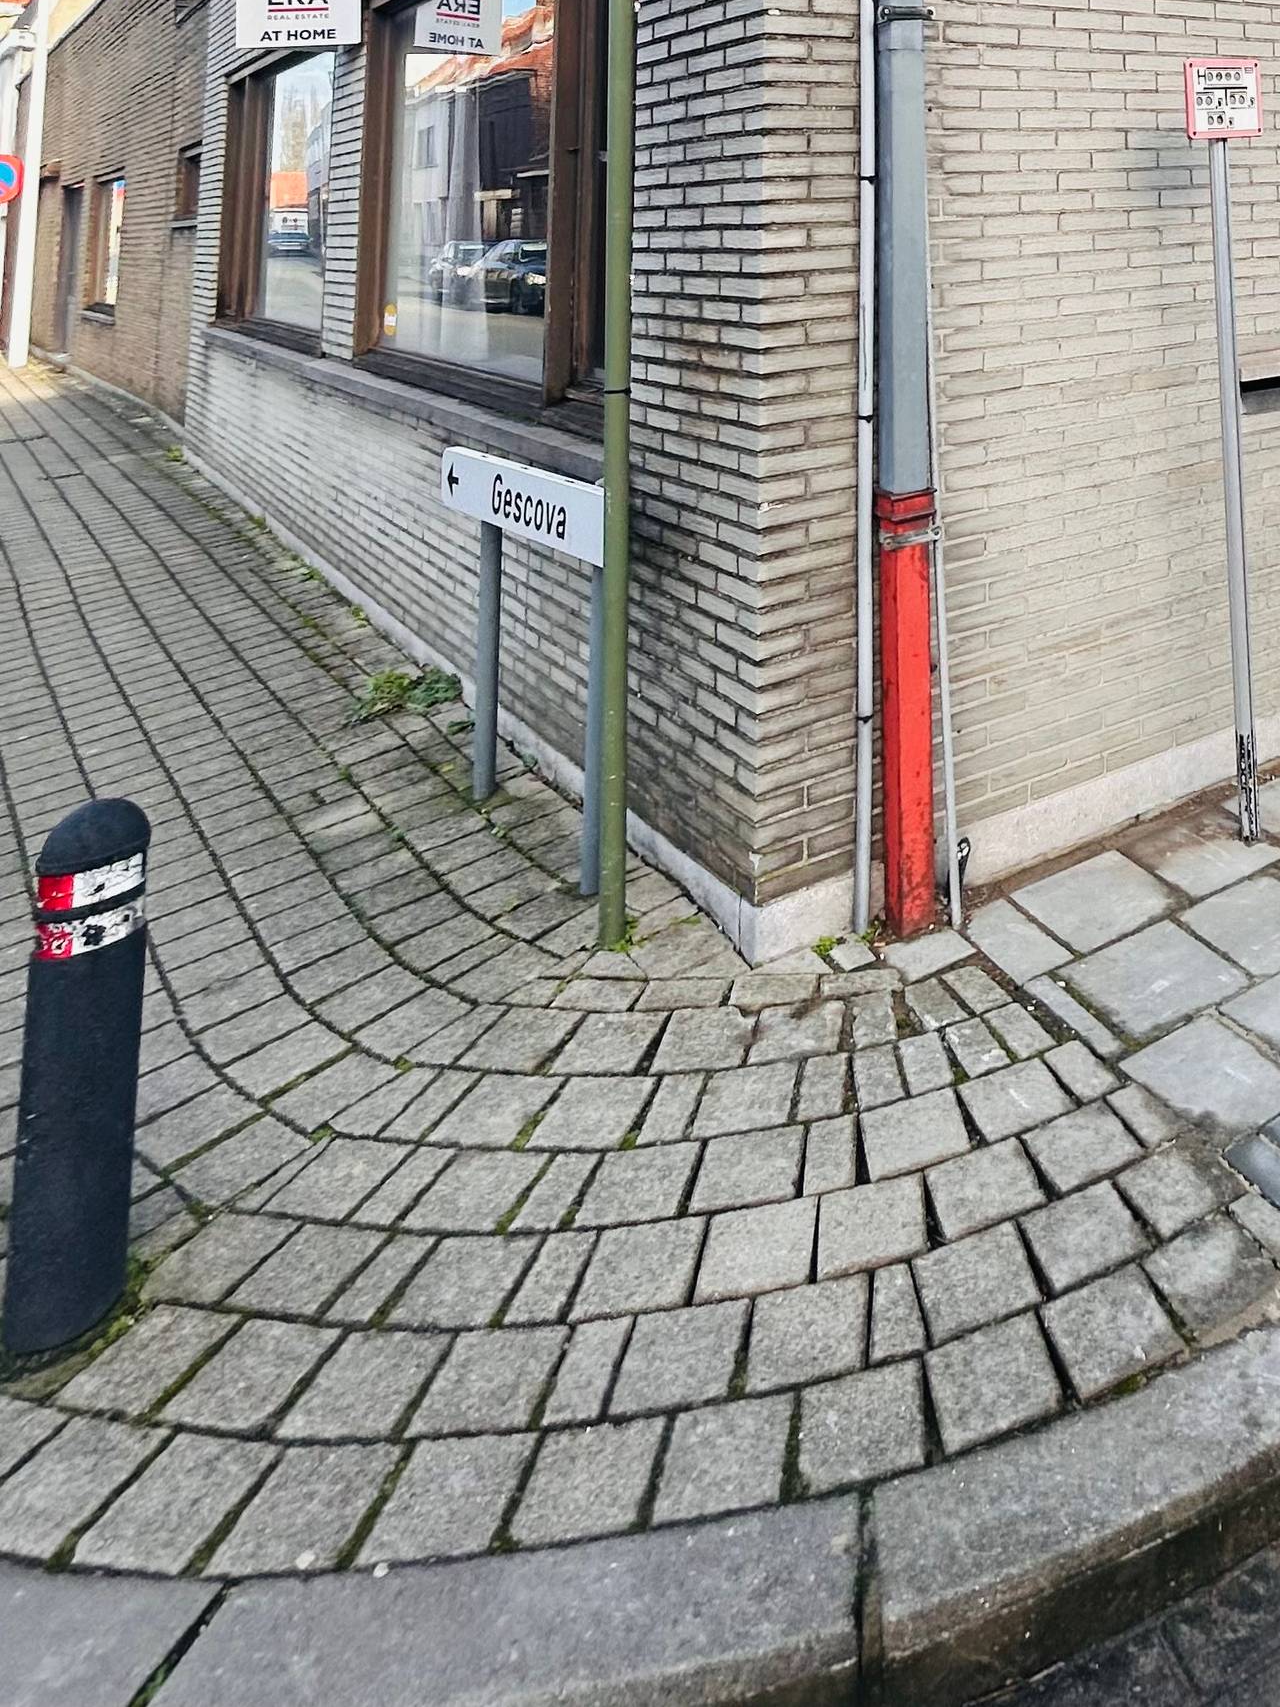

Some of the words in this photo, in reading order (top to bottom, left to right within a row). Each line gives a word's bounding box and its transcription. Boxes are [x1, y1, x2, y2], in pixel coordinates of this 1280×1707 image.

[260, 30, 283, 42] AT
[287, 29, 337, 41] HOME
[491, 473, 567, 541] Gescova
